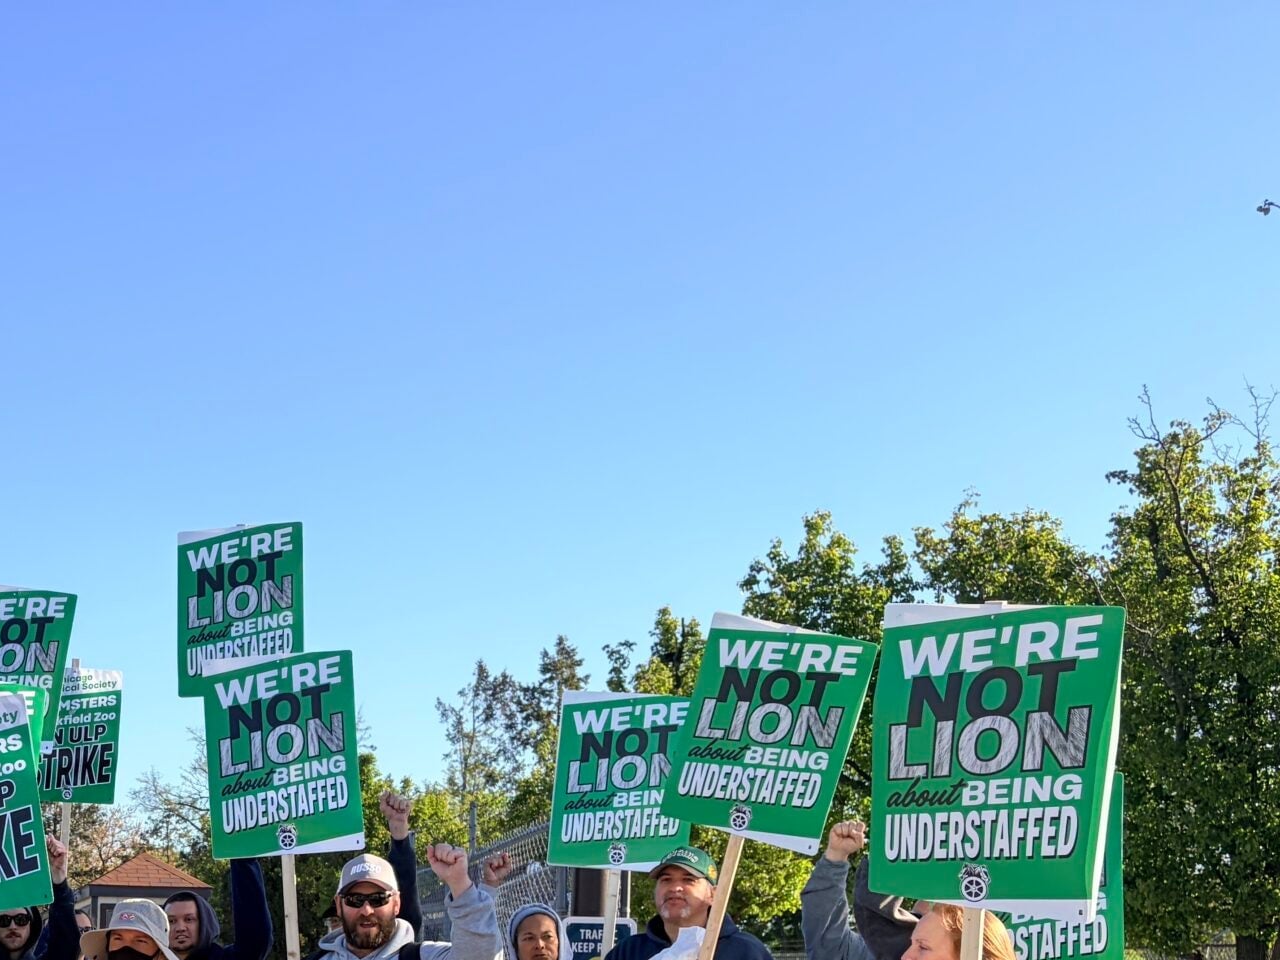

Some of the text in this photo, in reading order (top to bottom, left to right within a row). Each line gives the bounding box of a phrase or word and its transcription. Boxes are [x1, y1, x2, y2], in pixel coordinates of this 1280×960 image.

[187, 526, 293, 572] WE'RE
[196, 550, 283, 598] NOT
[187, 574, 294, 630] LION
[187, 611, 294, 645] about BEING
[898, 614, 1104, 680] WE'RE
[719, 638, 863, 676] WE'RE
[64, 673, 93, 684] icago
[82, 680, 117, 690] Society
[214, 656, 342, 710] WE'RE
[717, 666, 841, 708] NOT
[907, 658, 1078, 728] NOT
[57, 712, 116, 725] kfield Zoo
[59, 695, 117, 711] MSTERS
[228, 683, 331, 740] NOT
[573, 701, 691, 735] WE'RE
[70, 722, 107, 744] ULP
[580, 724, 678, 763] NOT
[694, 698, 845, 749] LION
[887, 704, 1093, 780] LION
[218, 711, 344, 779] LION
[687, 738, 830, 770] about BEING
[221, 754, 346, 797] about BEING
[677, 761, 822, 809] UNDERSTAFFED
[886, 773, 1083, 808] about BEING
[221, 774, 348, 835] UNDERSTAFFED
[564, 789, 665, 810] about BEIN
[562, 807, 680, 843] UNDERSTAFFED
[884, 805, 1078, 861] UNDERSTAFFED
[571, 941, 595, 953] KEEP
[580, 928, 618, 940] TRAF
